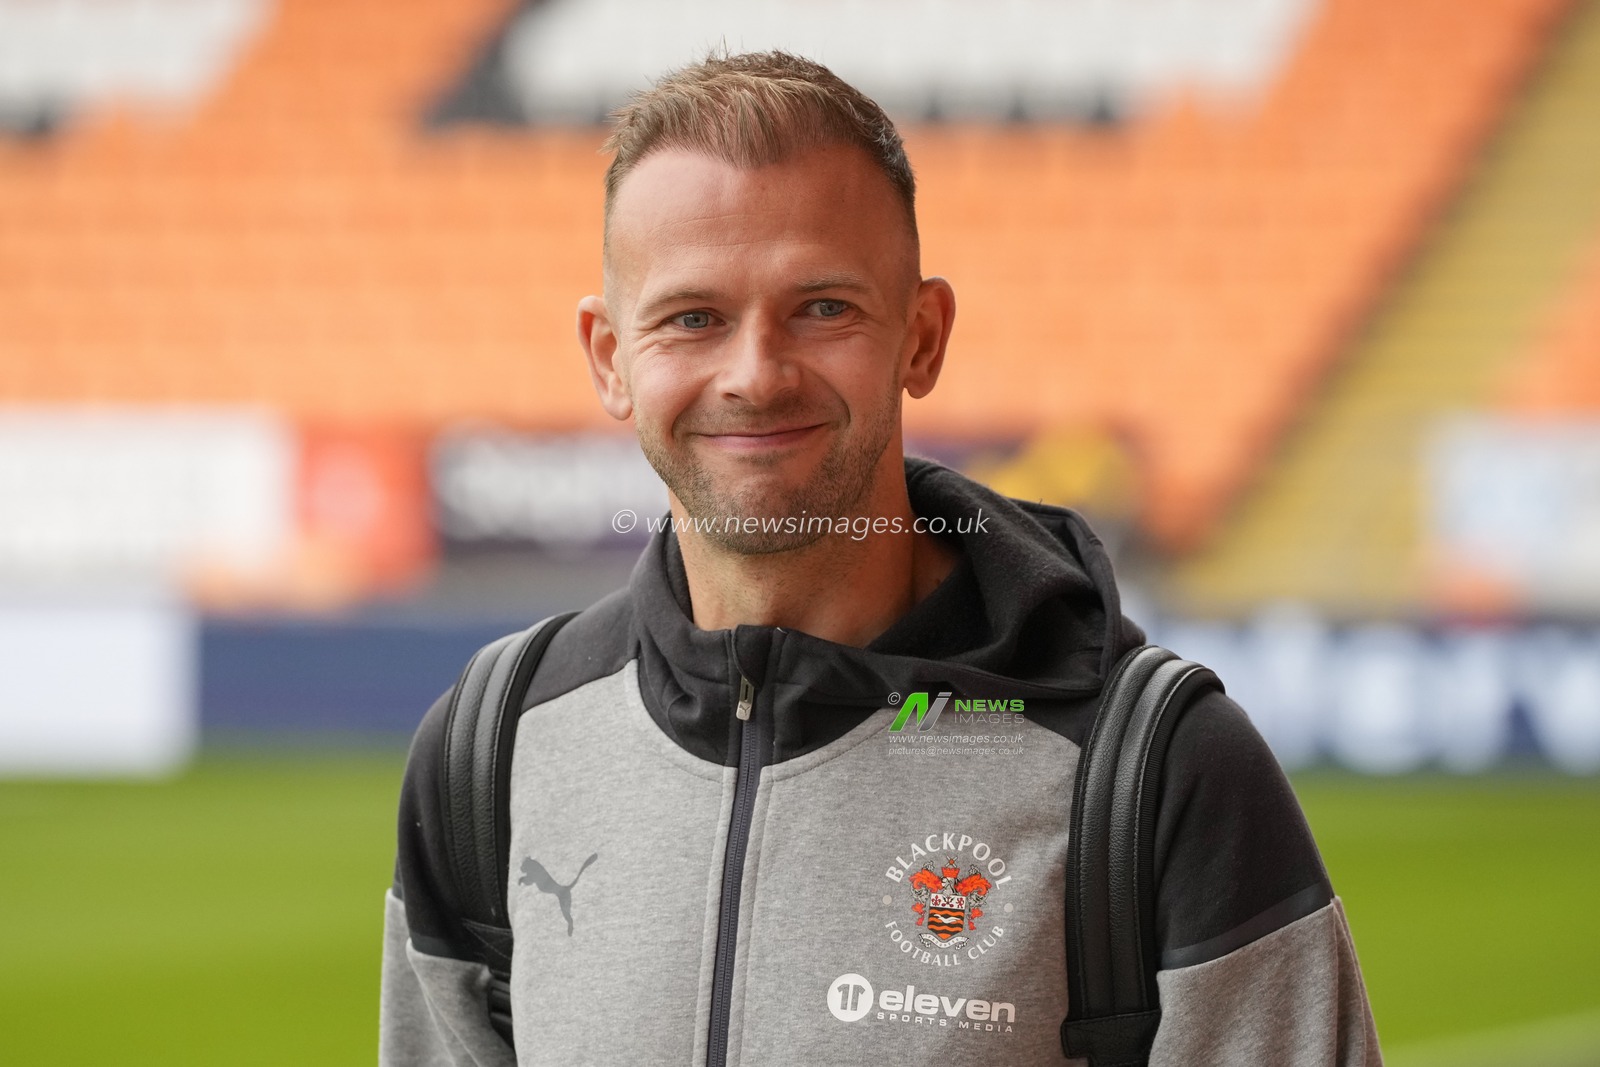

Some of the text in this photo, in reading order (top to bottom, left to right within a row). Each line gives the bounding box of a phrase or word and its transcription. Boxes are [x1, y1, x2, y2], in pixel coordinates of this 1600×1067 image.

[885, 832, 1012, 890] BLACKPOOL
[885, 920, 961, 967] FOOTBALL
[967, 925, 1004, 960] CLUB
[876, 1012, 1013, 1033] SPORTS MEDIA
[879, 984, 1016, 1023] eleven
